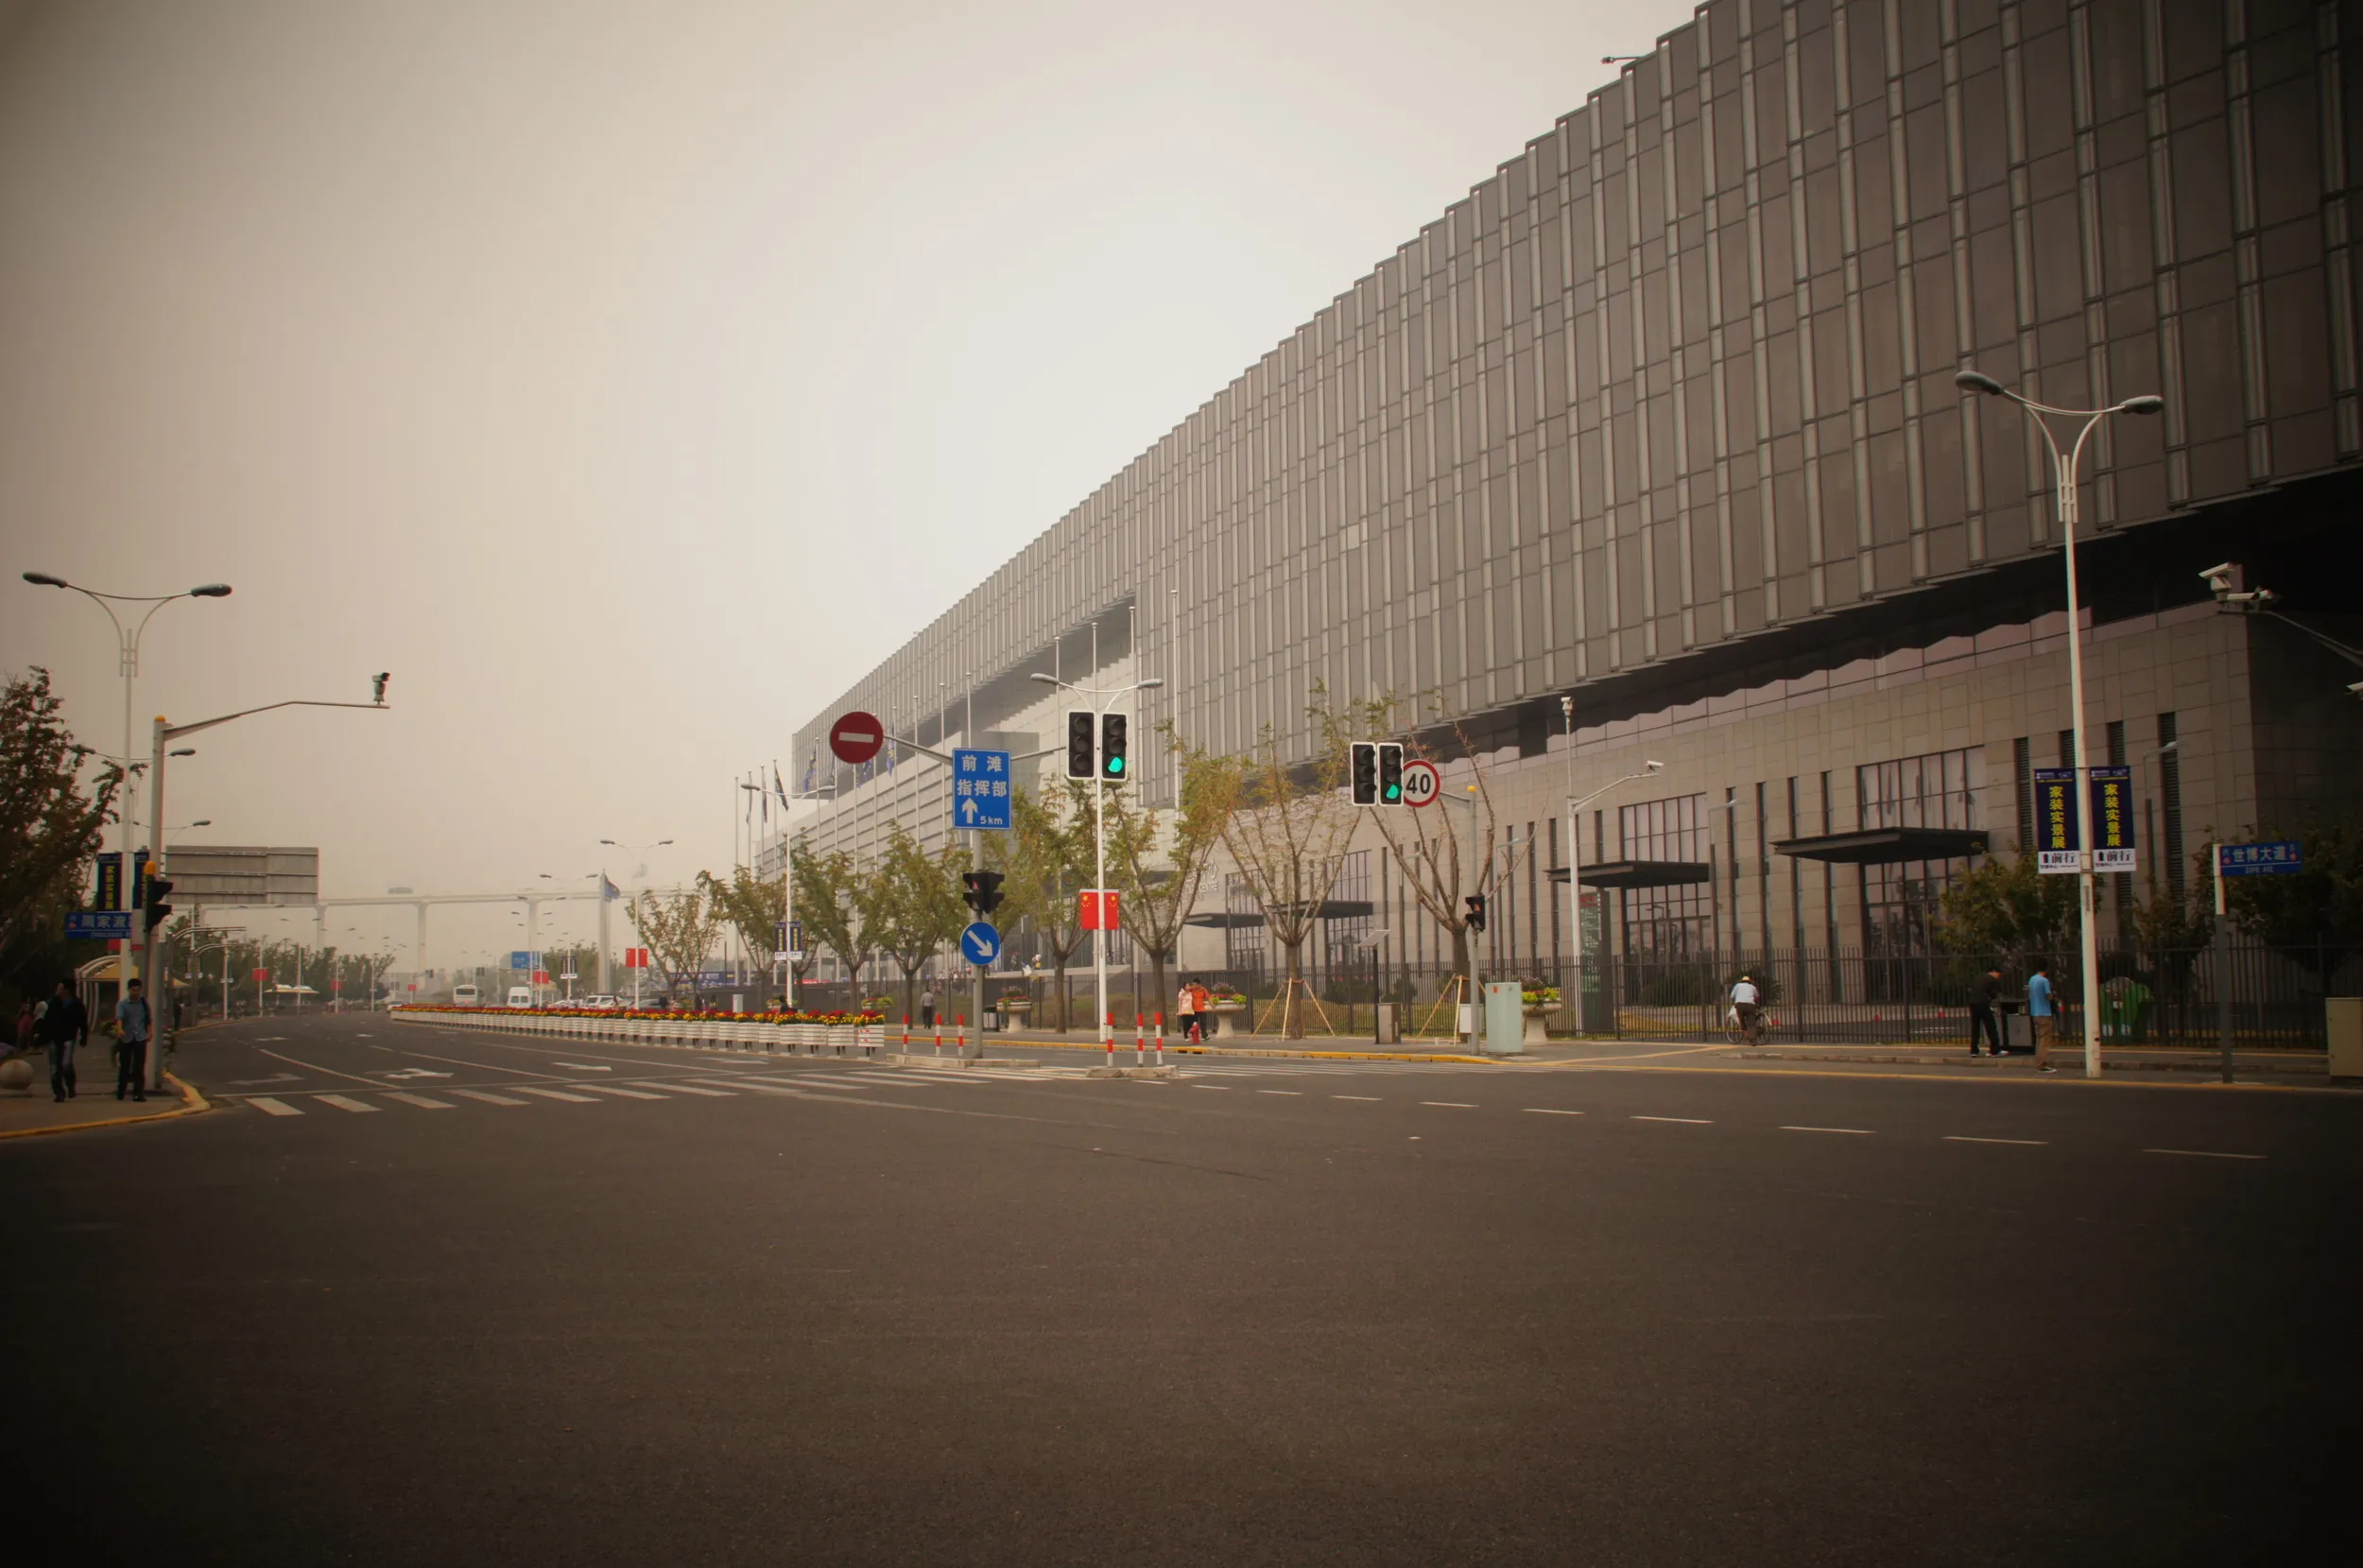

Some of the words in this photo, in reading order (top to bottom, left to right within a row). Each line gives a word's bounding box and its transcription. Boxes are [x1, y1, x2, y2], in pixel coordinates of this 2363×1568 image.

[961, 754, 1002, 772] 前滩
[957, 779, 1007, 798] 指挥部
[1406, 773, 1431, 794] 40
[2049, 785, 2065, 849] 家装实景展
[2104, 783, 2121, 847] 家装实景展
[2233, 845, 2288, 863] 世博大道
